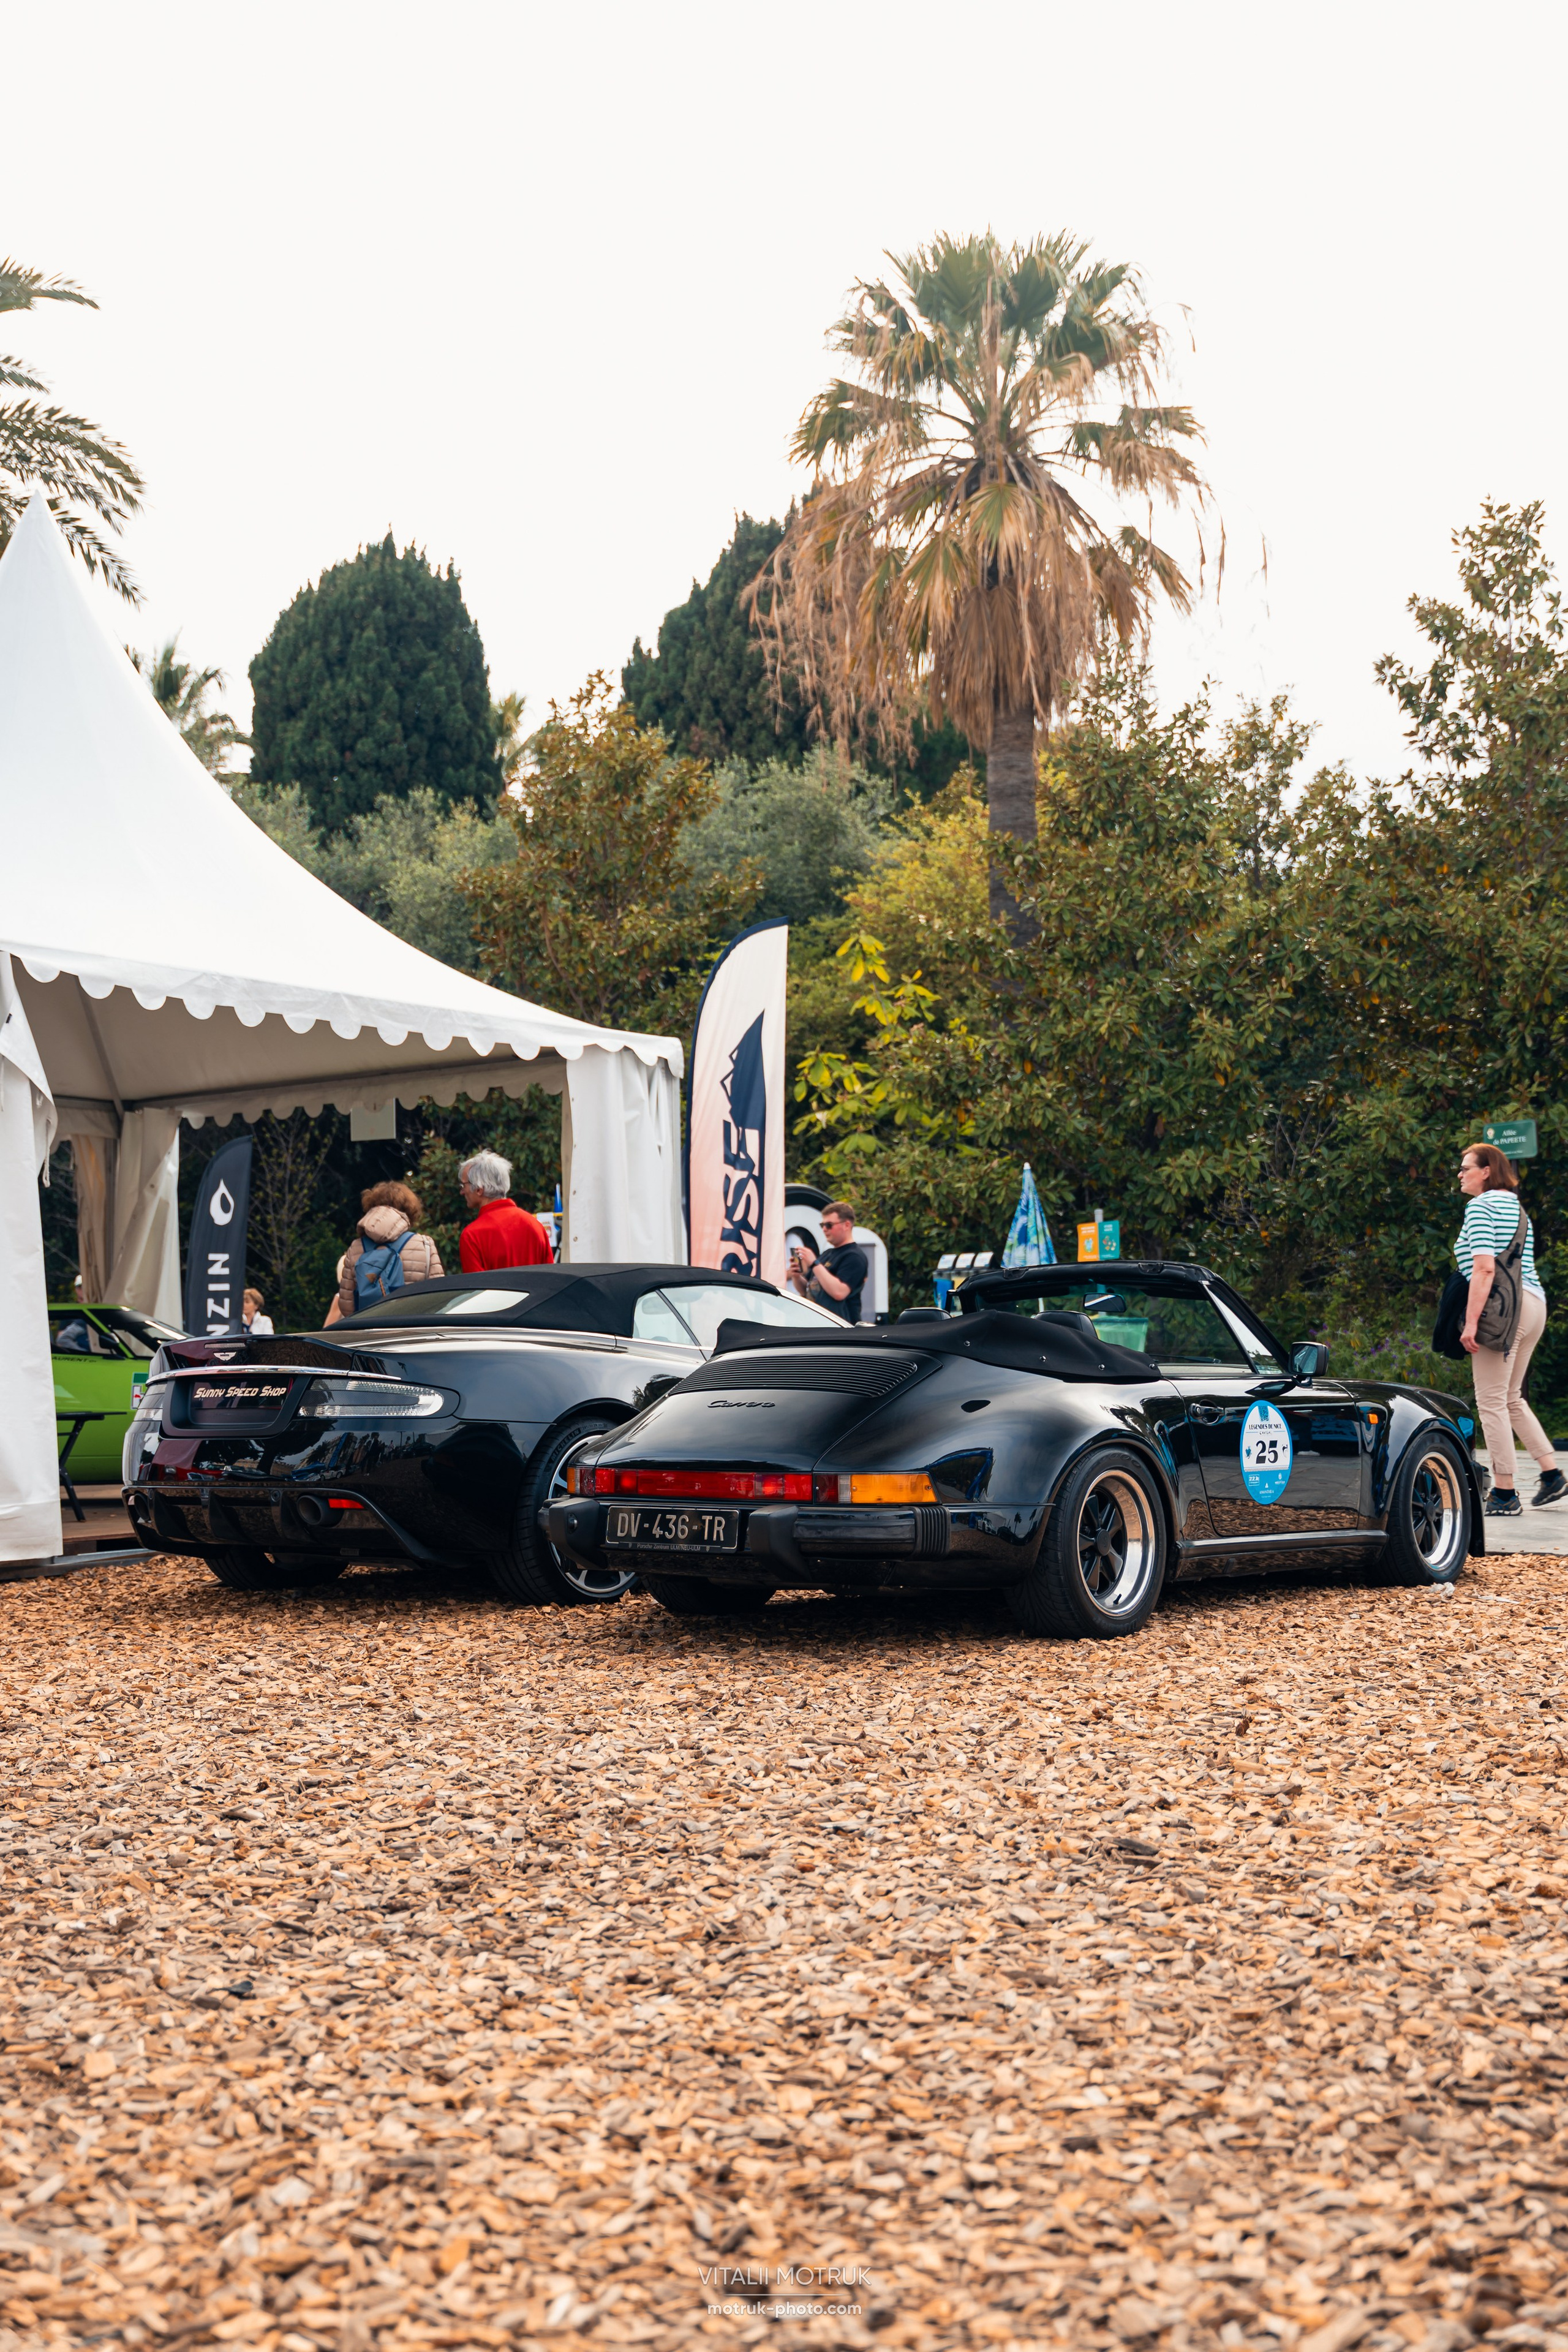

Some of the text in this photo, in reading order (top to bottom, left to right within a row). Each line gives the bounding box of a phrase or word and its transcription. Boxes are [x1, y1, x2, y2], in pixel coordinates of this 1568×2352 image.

[1500, 1136, 1526, 1144] PAPEETE
[551, 1428, 581, 1462] MICHELIN
[1256, 1440, 1278, 1464] 25
